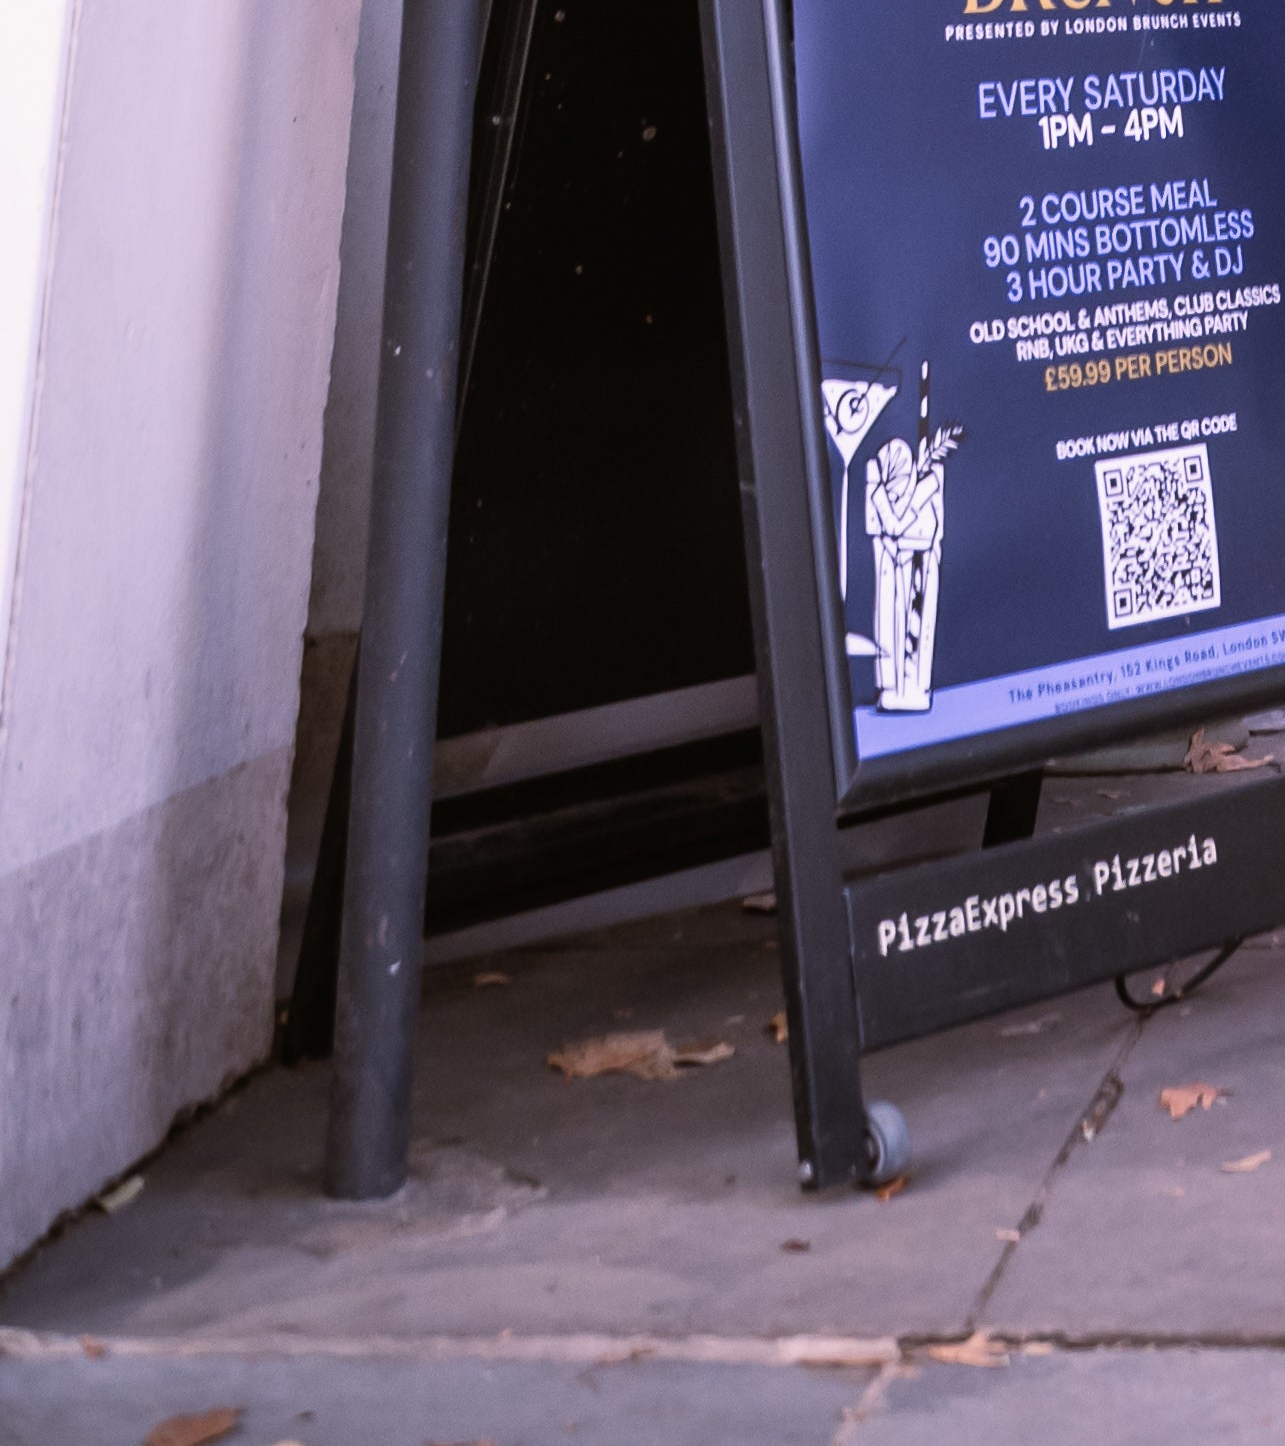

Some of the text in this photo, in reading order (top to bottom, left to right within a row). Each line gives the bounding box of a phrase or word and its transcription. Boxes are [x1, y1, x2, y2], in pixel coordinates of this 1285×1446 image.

[945, 11, 1241, 42] PRESENTED BY LONDON BRUNCH EVENTS
[978, 66, 1226, 118] EVERY SATURDAY
[1038, 112, 1093, 149] 1PM
[1124, 105, 1184, 142] 4PM
[1019, 178, 1217, 227] 2 COURSE MEAL
[983, 209, 1255, 268] 90 MINS BOTTOMLESS
[1006, 245, 1244, 302] 3 HOUR PARTY & DJ
[970, 283, 1281, 343] OLD SCHOOL & ANTHEMS, CLUB CLASSICS
[1016, 311, 1248, 361] RNB, UKG & EVERYTHING PARTY
[1045, 343, 1233, 391] £59.99 PER PERSON
[1056, 413, 1238, 459] BOOK NOW VIA THE QR CODE
[1009, 688, 1033, 704] The
[1223, 636, 1268, 655] London
[878, 834, 1217, 956] PizzaExpress Pizzeria
